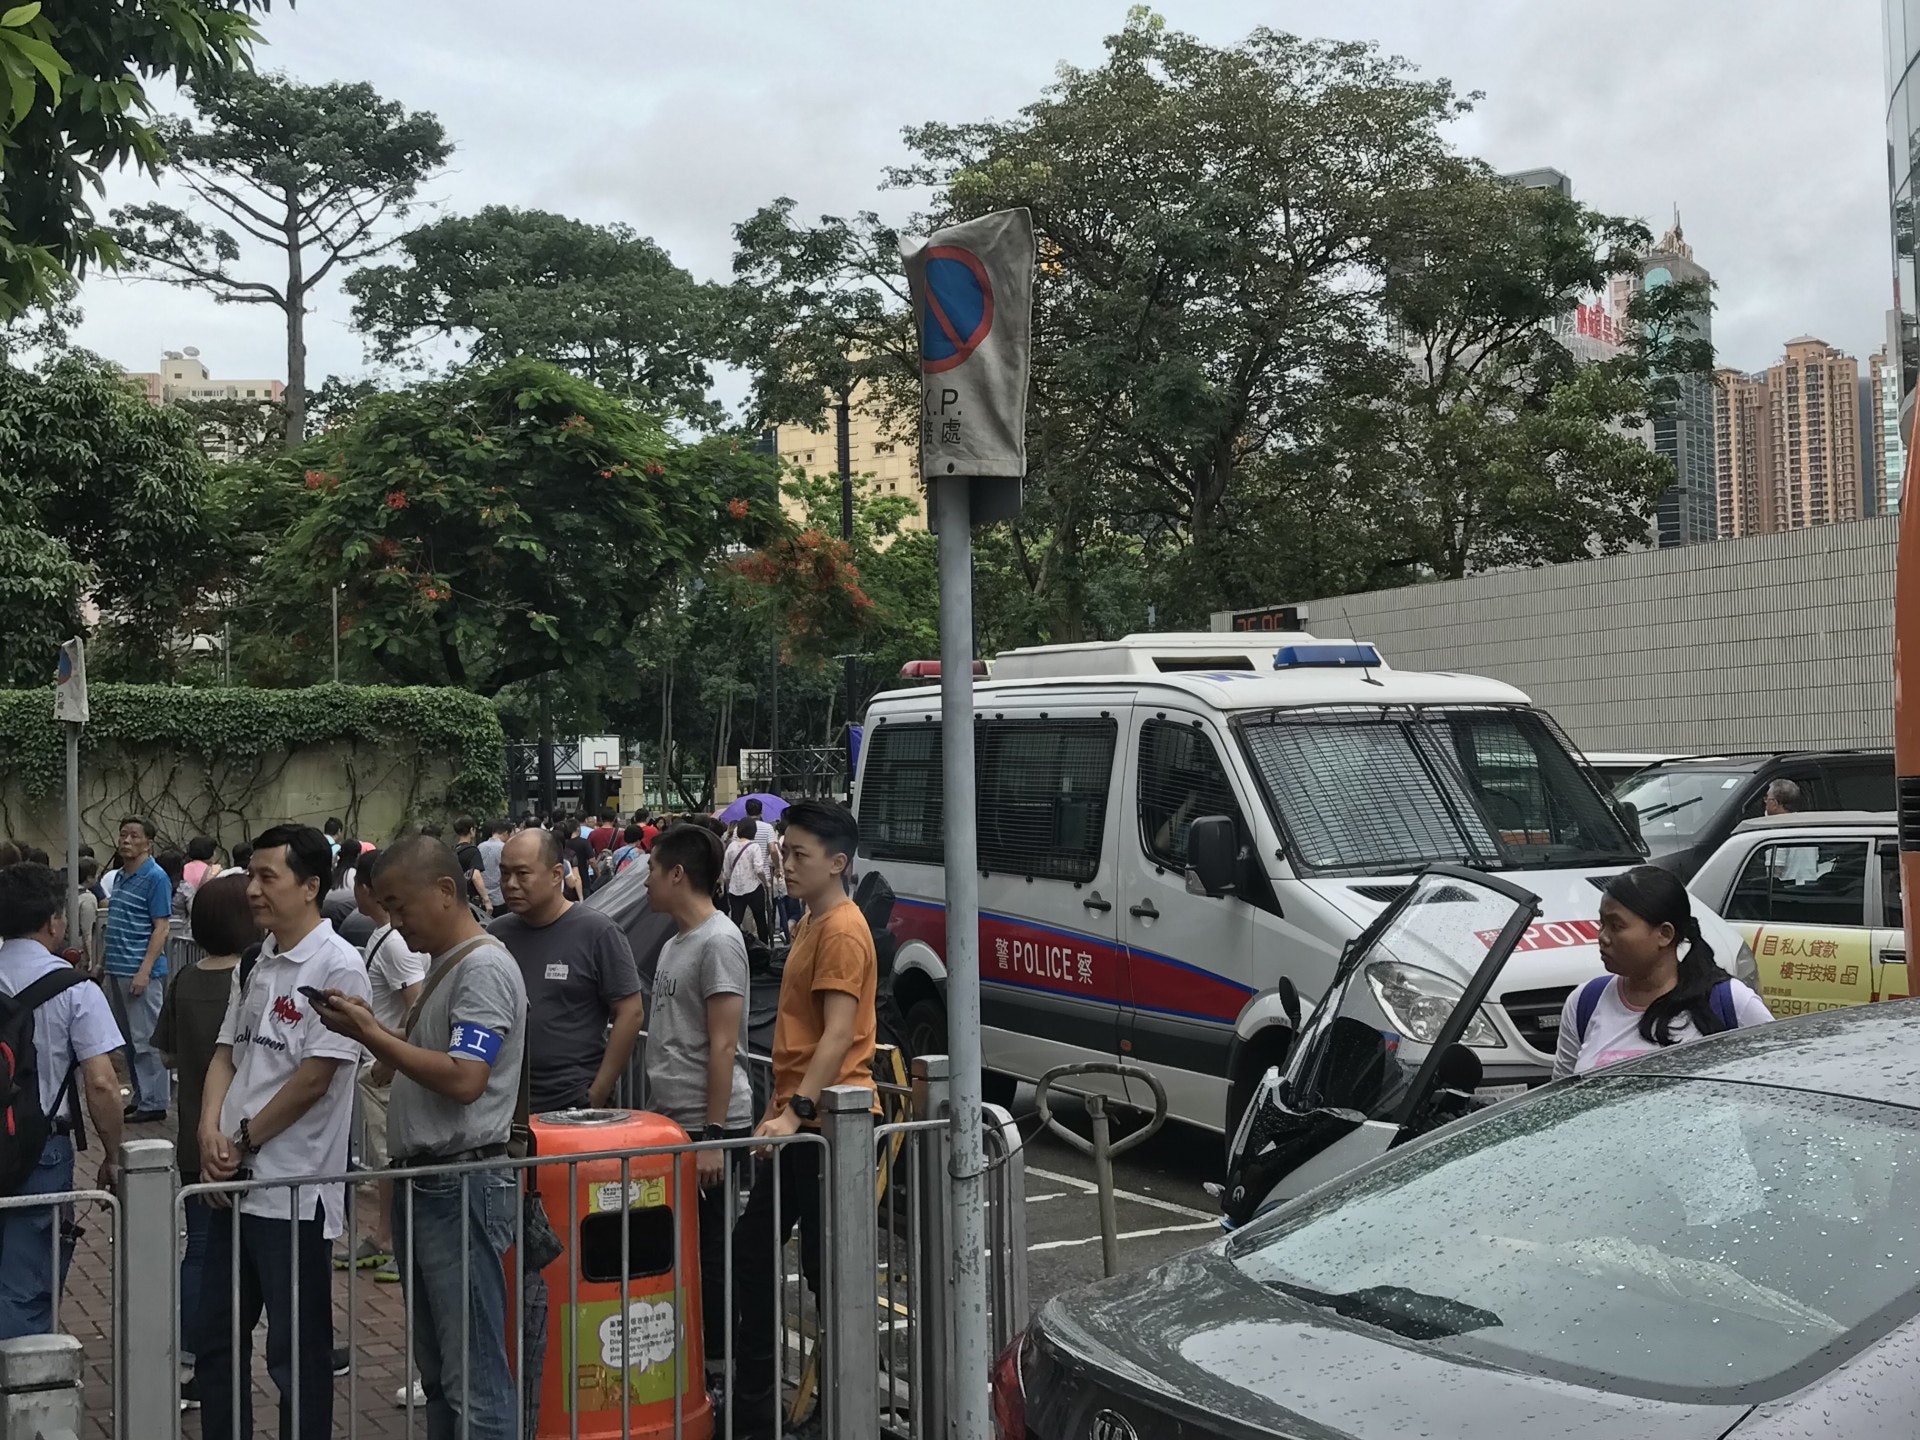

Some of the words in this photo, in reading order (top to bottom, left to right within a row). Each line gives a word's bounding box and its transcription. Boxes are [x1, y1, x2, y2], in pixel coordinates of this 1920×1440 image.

[1780, 938, 1838, 959] 私人貸款
[995, 937, 1009, 969] 警
[1013, 940, 1073, 982] POLICE
[1077, 951, 1093, 984] 察
[1780, 961, 1837, 983] 樓宇按揭
[1770, 998, 1810, 1016] 2391
